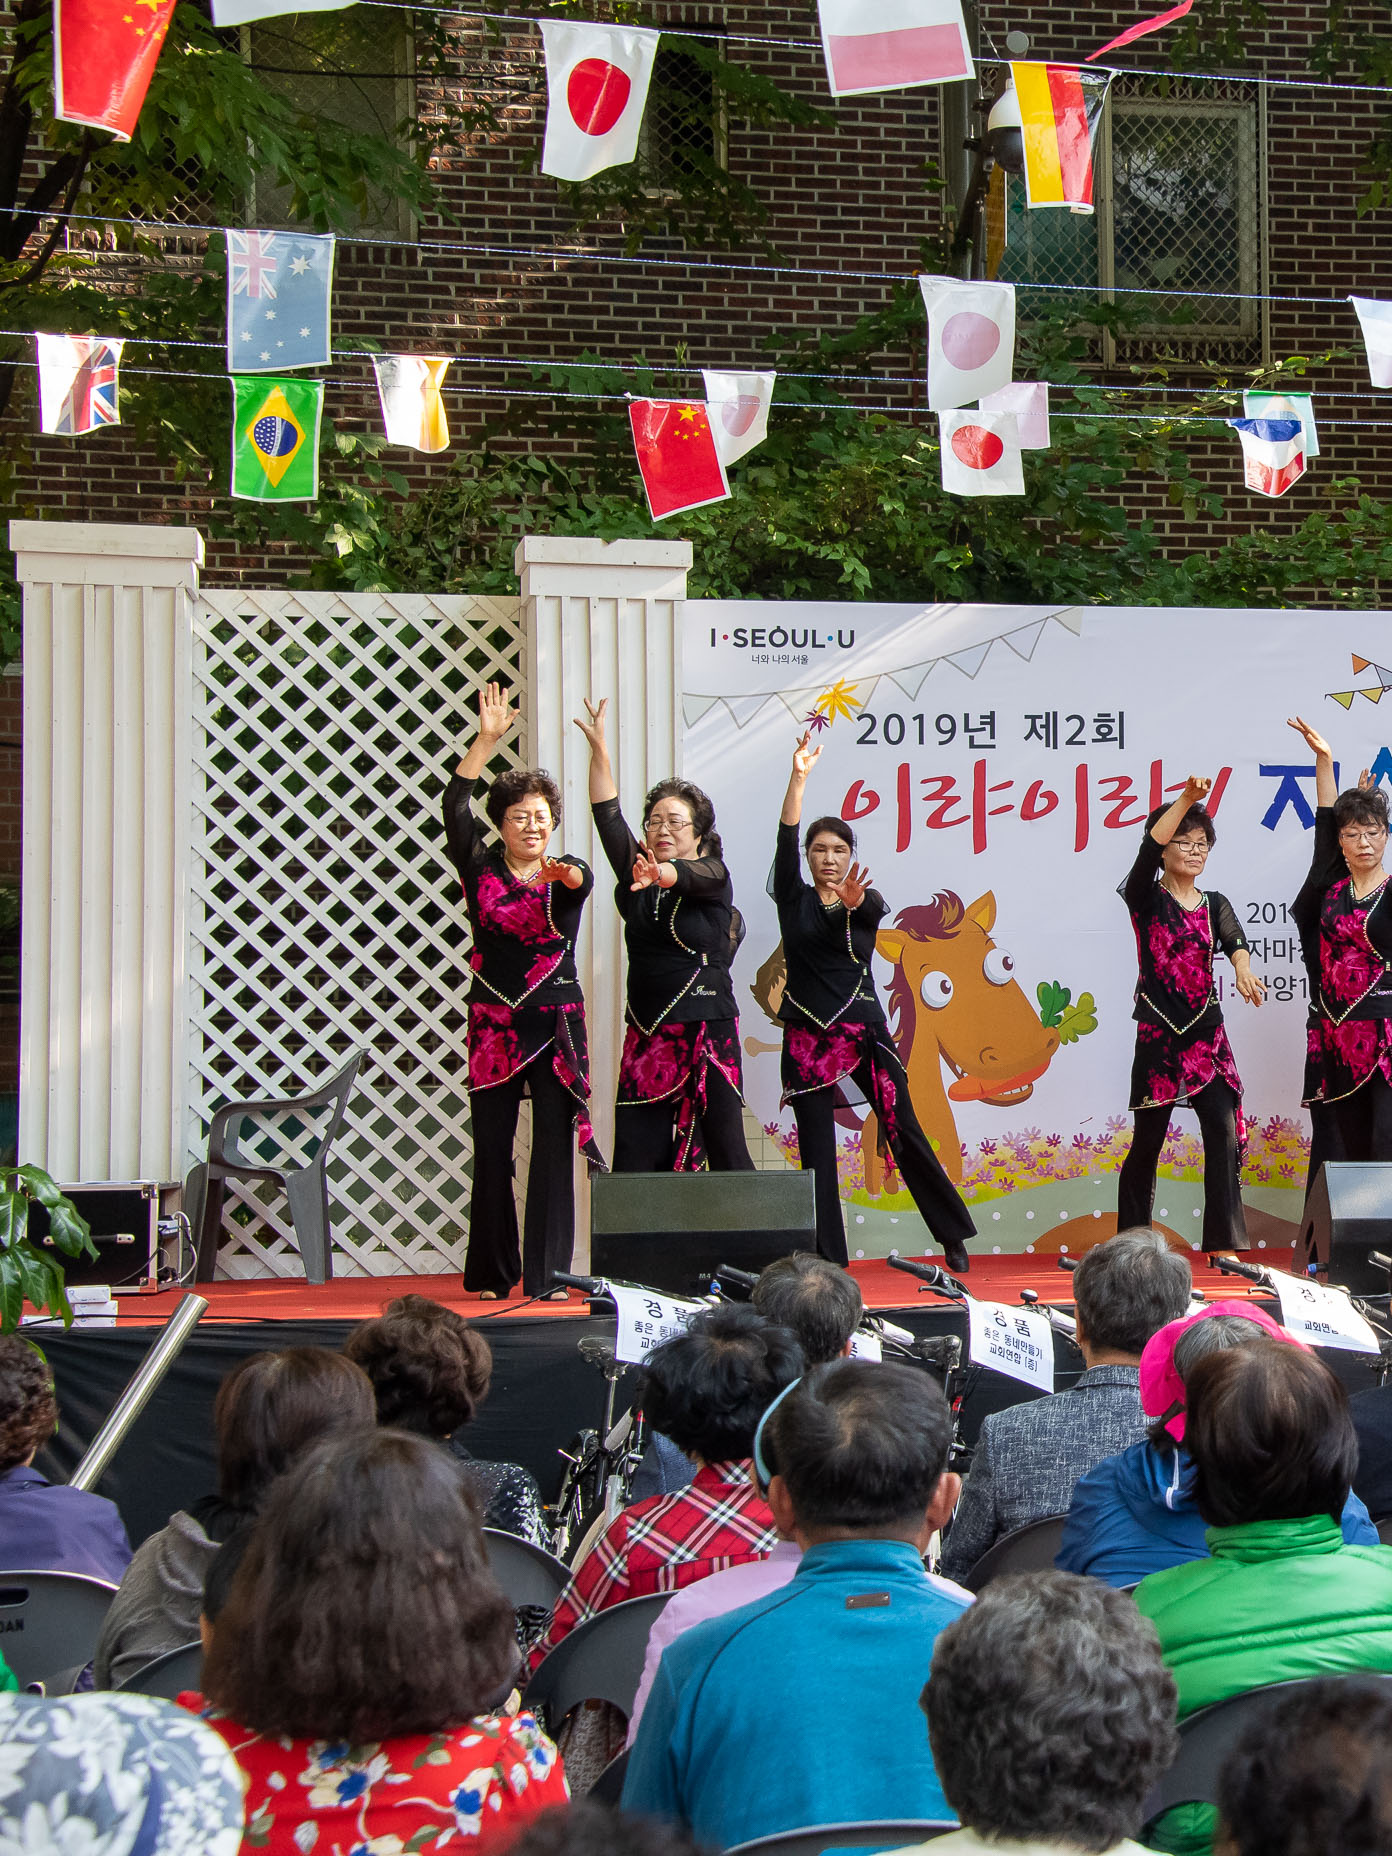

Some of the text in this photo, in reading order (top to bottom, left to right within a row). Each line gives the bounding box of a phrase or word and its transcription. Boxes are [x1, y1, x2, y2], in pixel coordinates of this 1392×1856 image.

[751, 654, 809, 665] 너와 나의 서울
[856, 711, 1126, 750] 2019년 제2회
[1249, 937, 1305, 964] 자마
[643, 1299, 689, 1324] 경 품
[993, 1307, 1031, 1338] 경 품
[984, 1326, 1043, 1360] 좋은 동네만들기
[989, 1342, 1021, 1364] 교회연합
